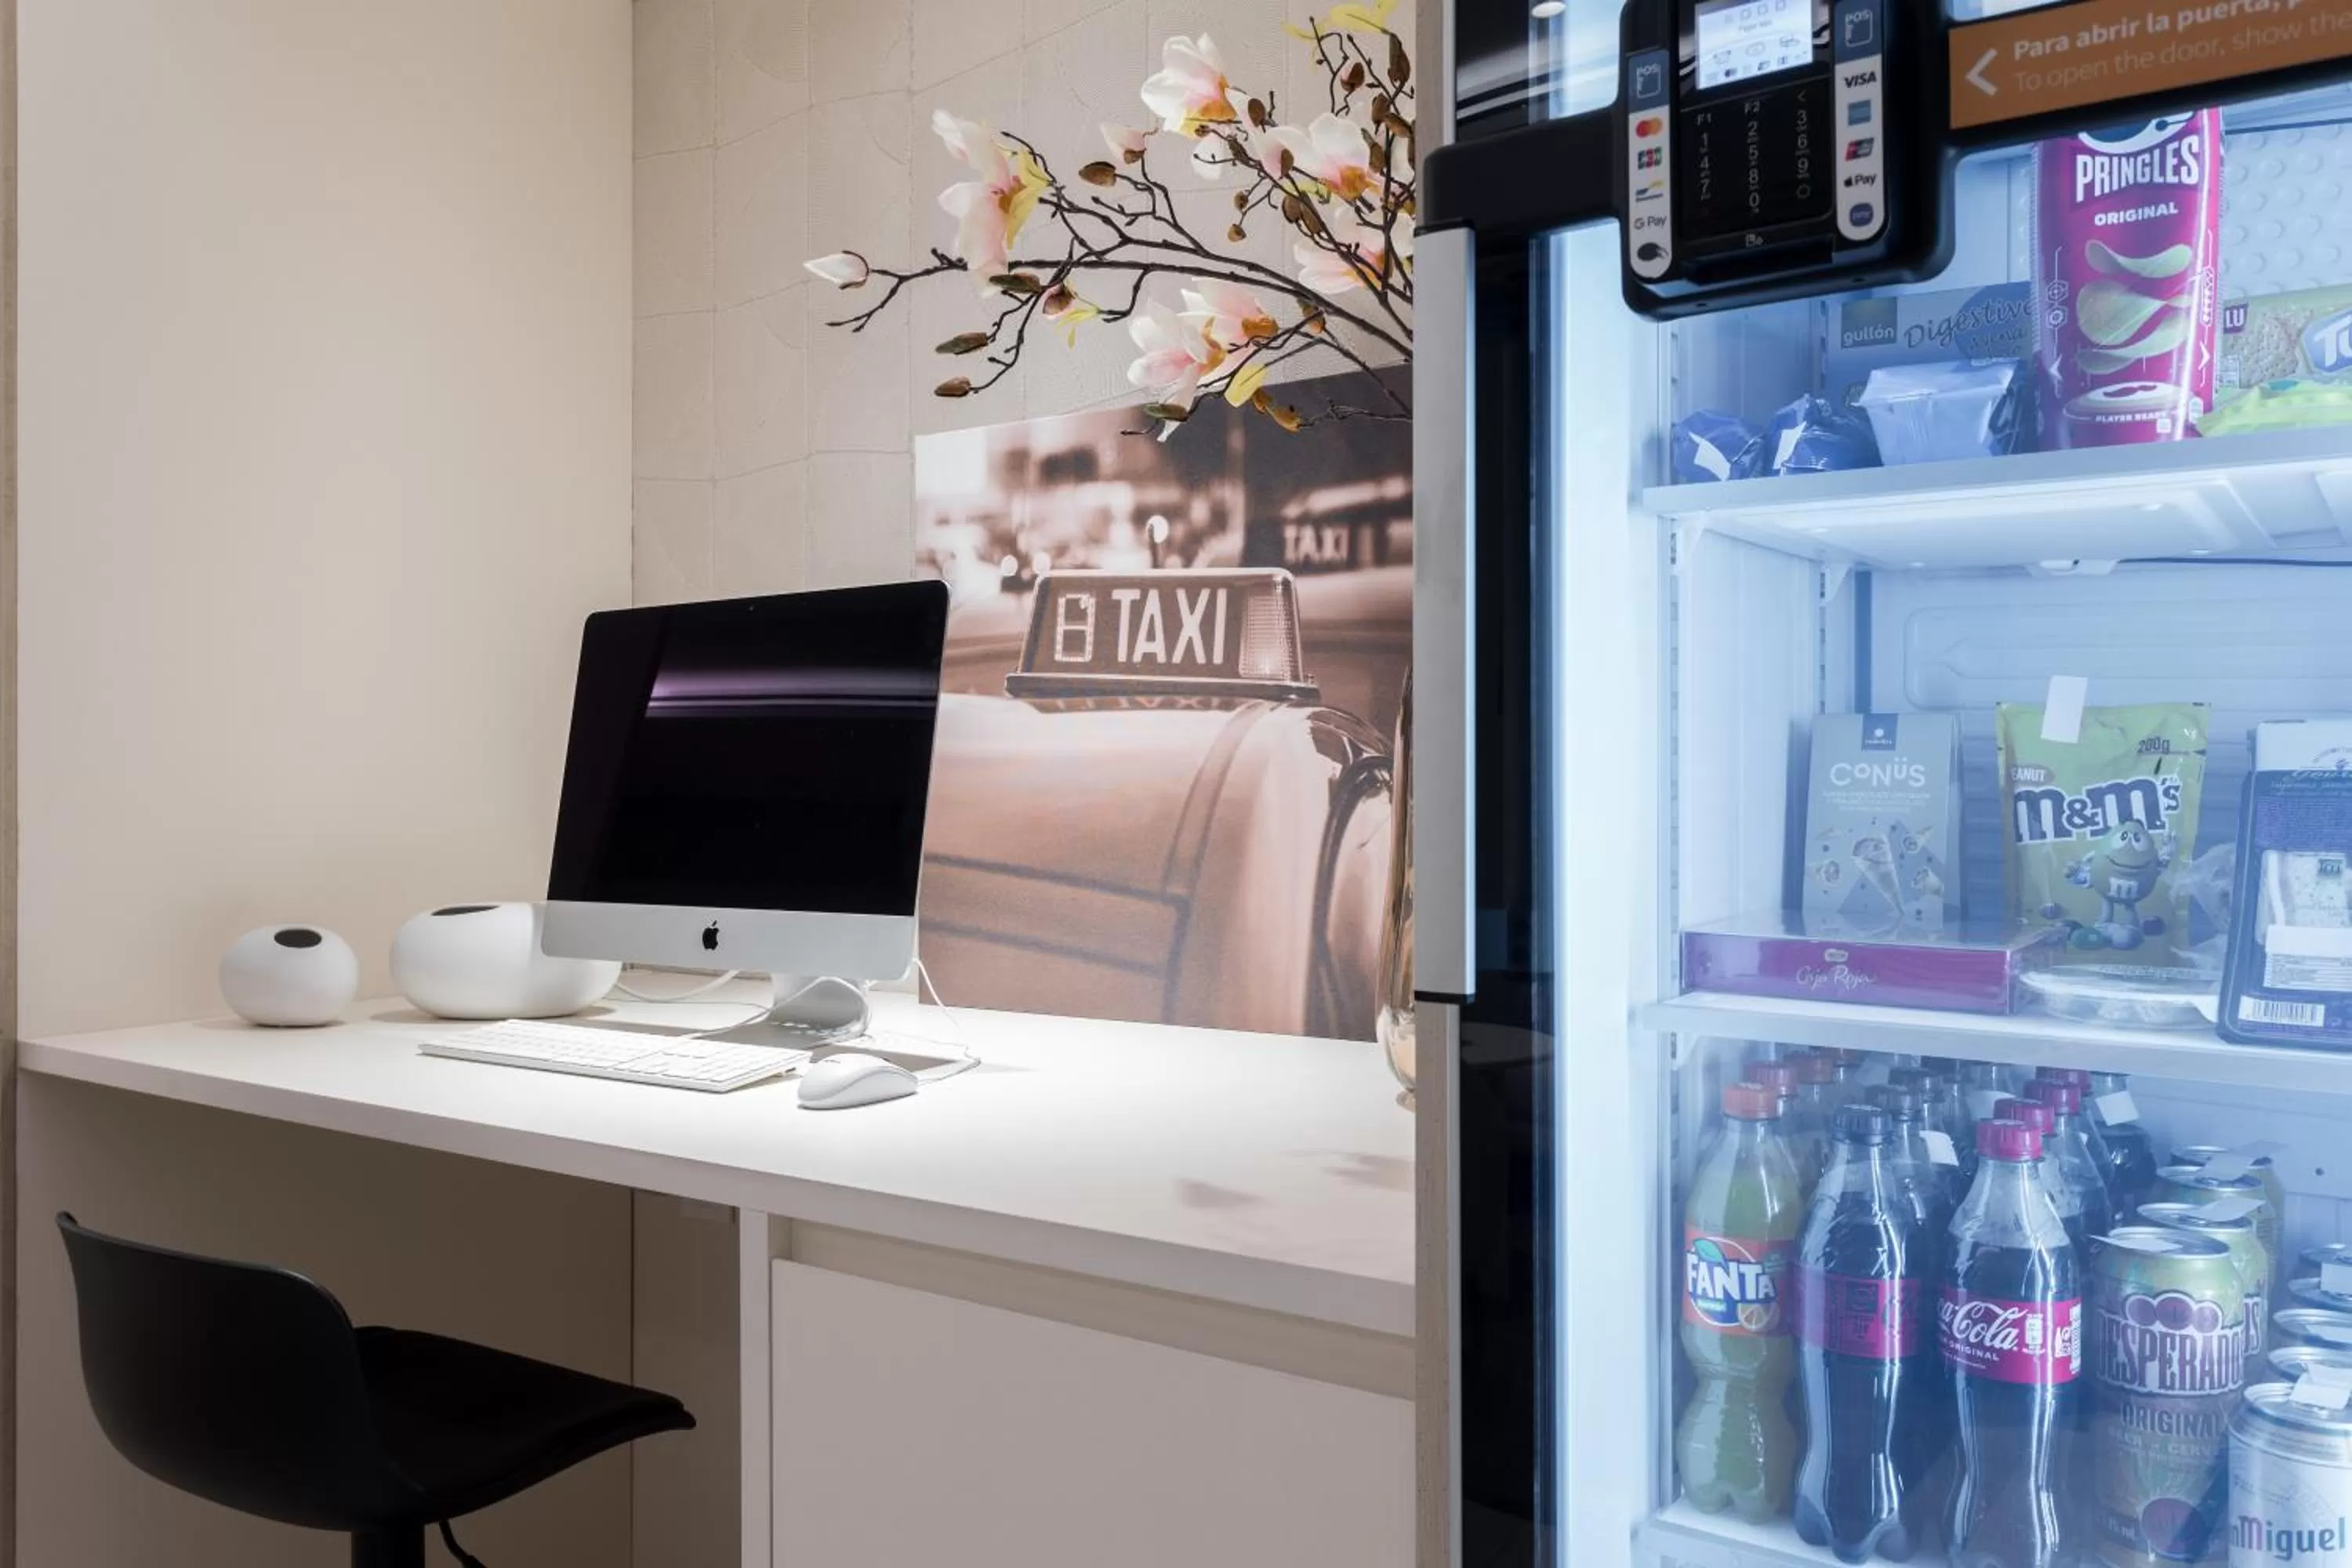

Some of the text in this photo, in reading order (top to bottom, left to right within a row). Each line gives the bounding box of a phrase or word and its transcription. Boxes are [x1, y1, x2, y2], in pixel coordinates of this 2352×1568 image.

[2014, 0, 2279, 60] Para abrir la puerta,
[2013, 71, 2042, 91] To
[2047, 60, 2109, 89] open
[2114, 50, 2154, 74] the
[2233, 22, 2303, 51] show
[1844, 71, 1877, 88] VISA
[1748, 169, 1759, 183] 8
[1855, 173, 1877, 187] Pay
[2076, 134, 2199, 204] PRINGLES
[1647, 216, 1668, 227] Pay
[2094, 201, 2179, 226] ORIGINAL
[2225, 307, 2244, 327] LU
[1843, 325, 1895, 346] gullón
[1283, 522, 1349, 565] TAXI
[1112, 588, 1229, 665] TAXI
[1686, 1252, 1776, 1301] FANTA
[2239, 1515, 2346, 1561] Miguel
